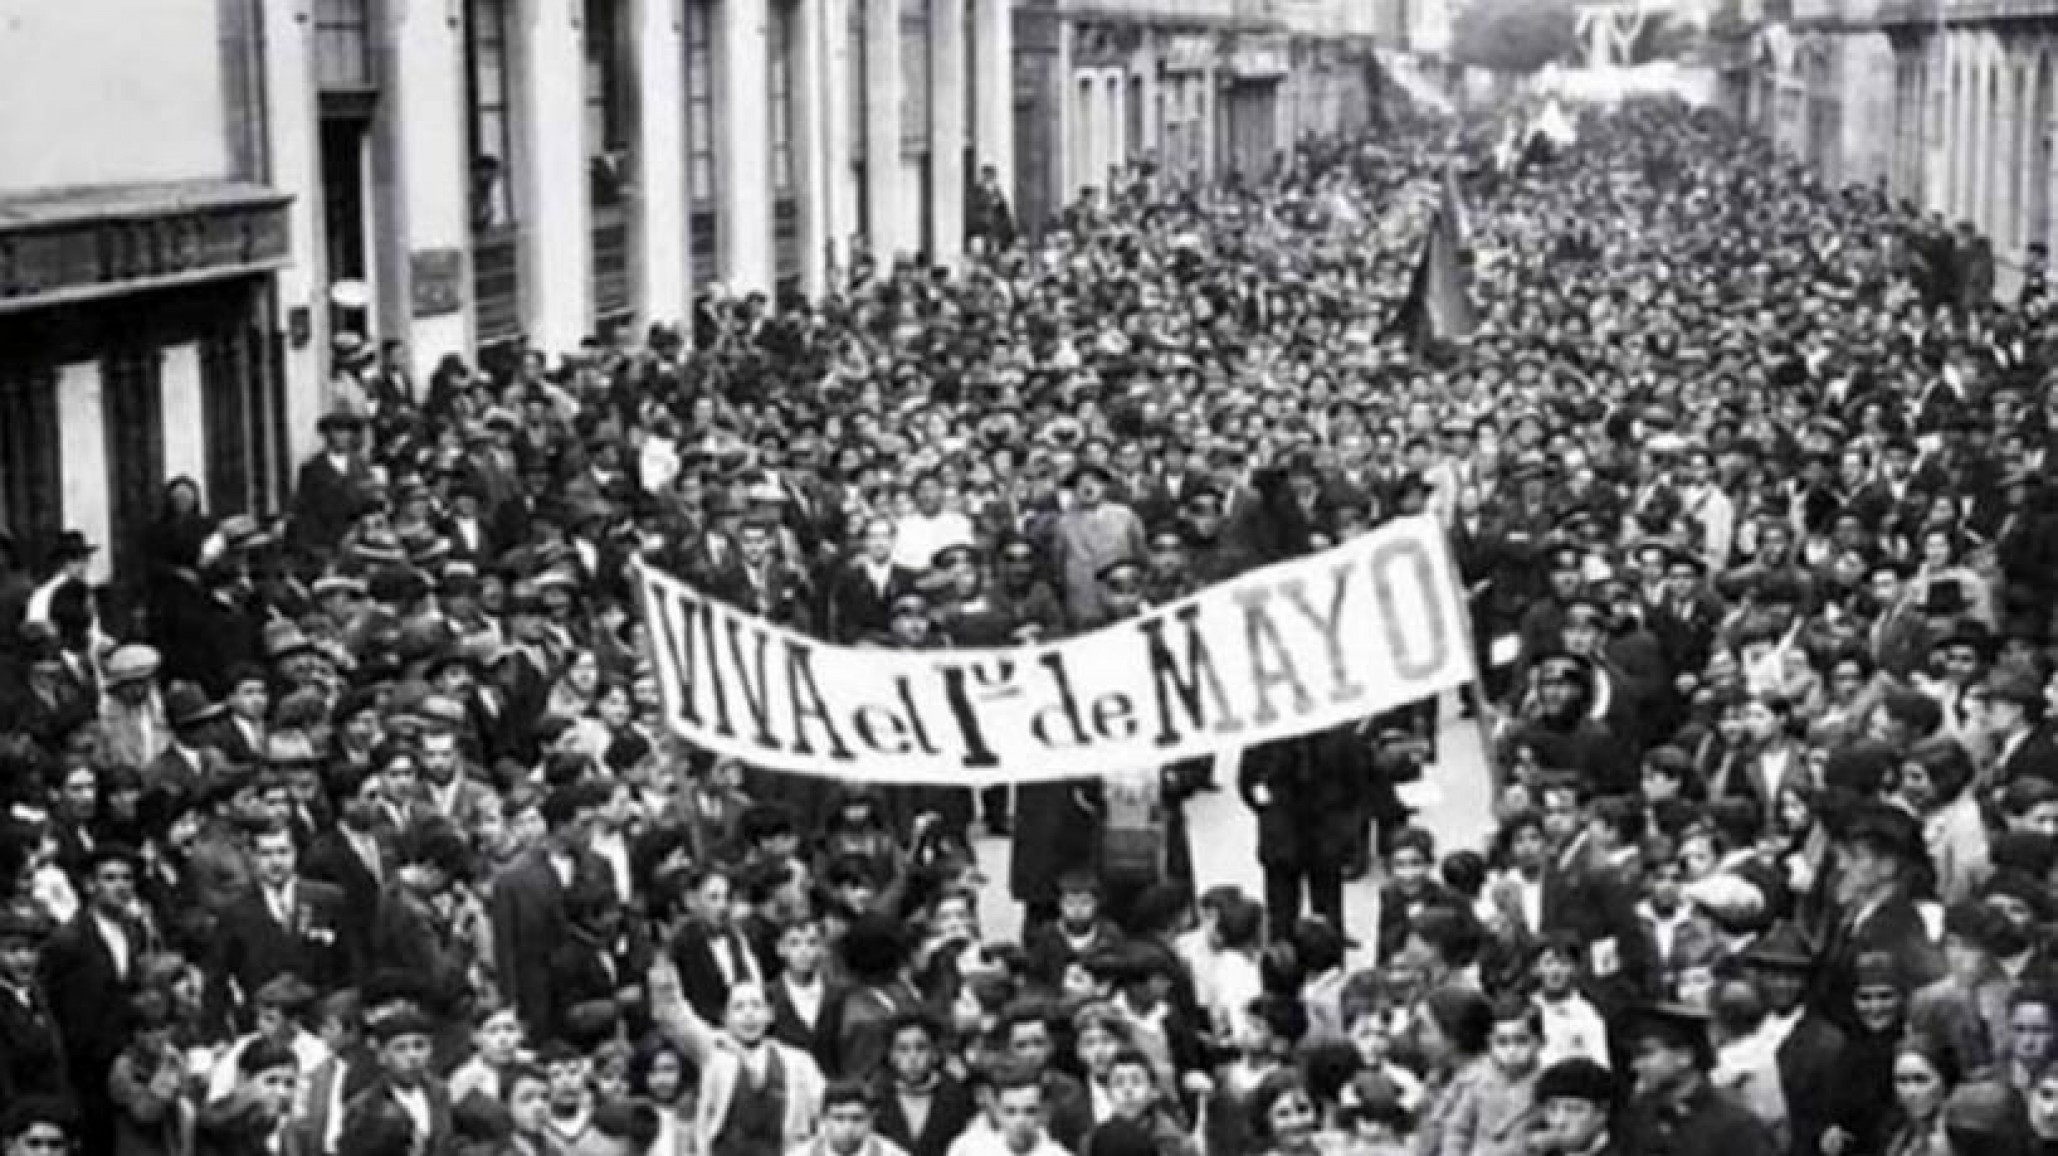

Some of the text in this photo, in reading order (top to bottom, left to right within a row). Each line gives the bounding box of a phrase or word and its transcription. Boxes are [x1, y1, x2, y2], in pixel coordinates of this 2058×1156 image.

[650, 582, 855, 758] VIVA
[852, 675, 941, 755] el
[1030, 650, 1138, 749] de
[1137, 538, 1448, 747] MAYO
